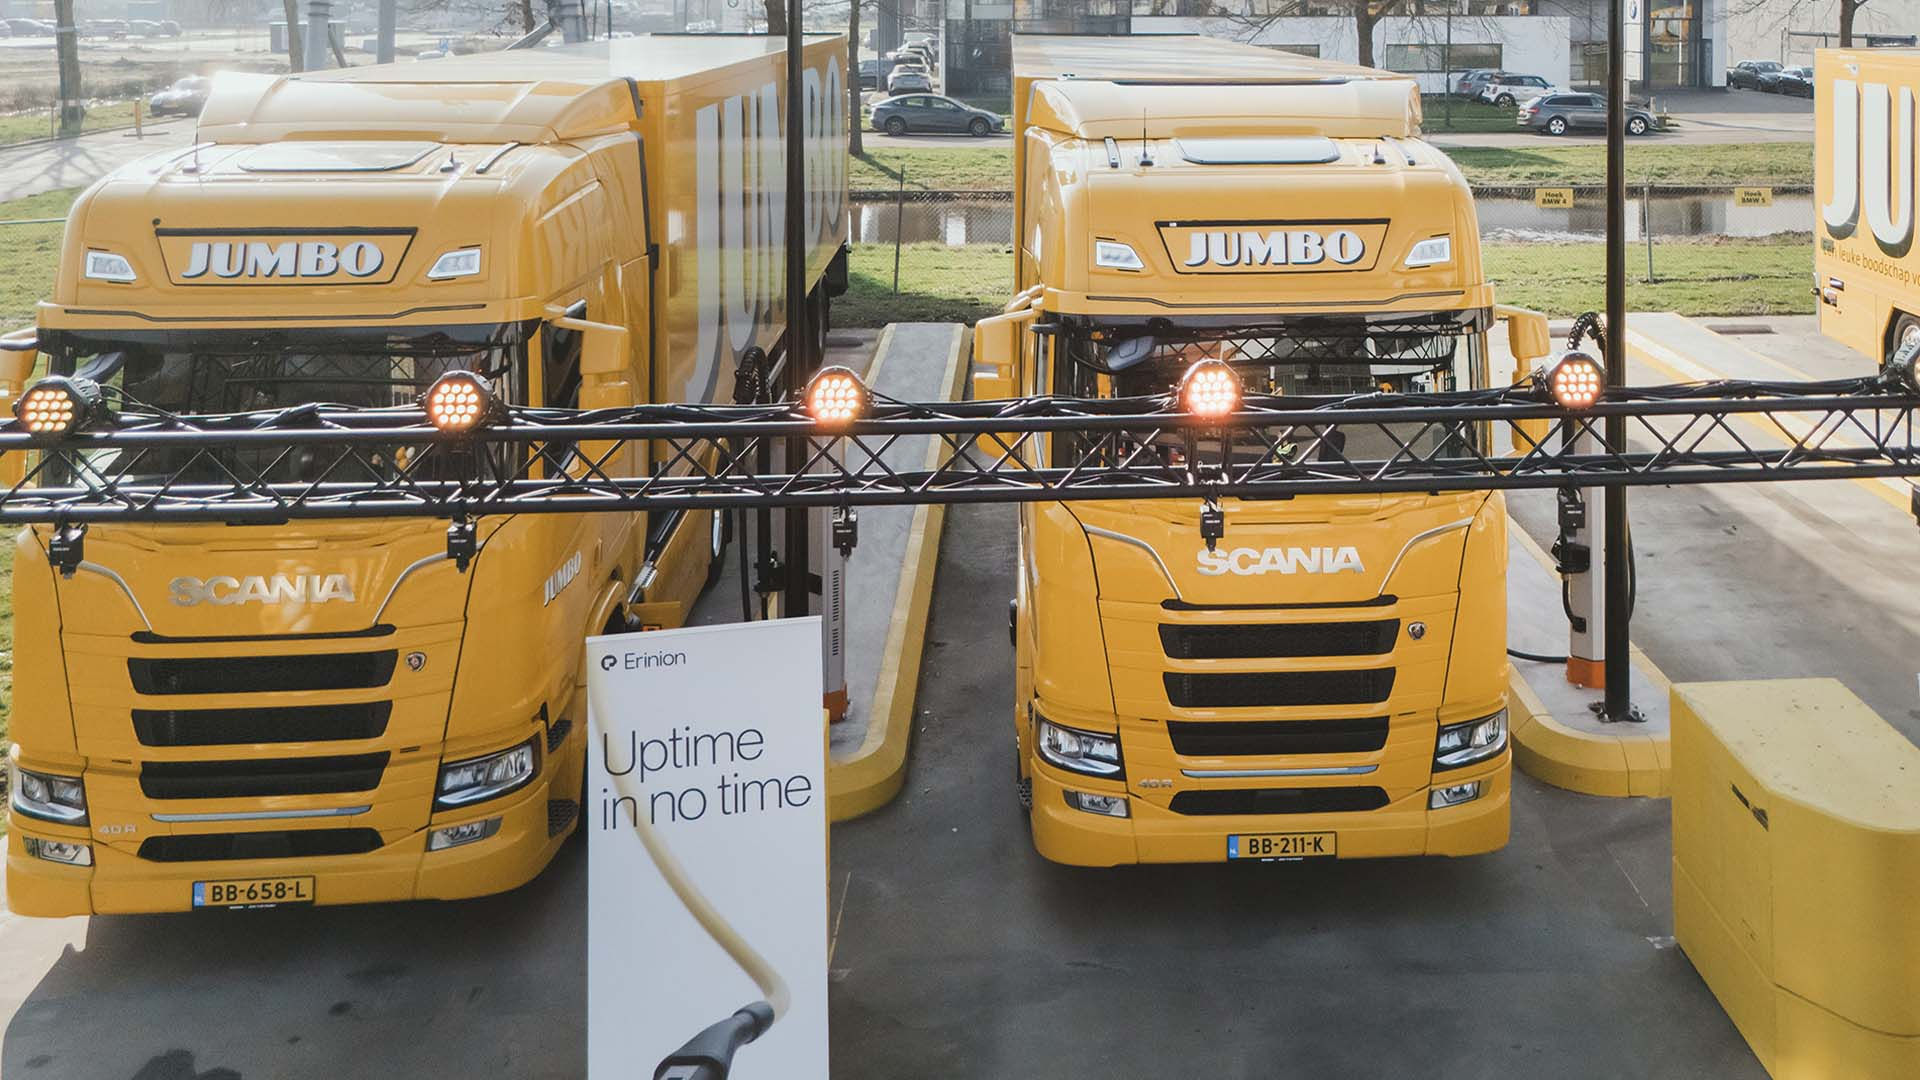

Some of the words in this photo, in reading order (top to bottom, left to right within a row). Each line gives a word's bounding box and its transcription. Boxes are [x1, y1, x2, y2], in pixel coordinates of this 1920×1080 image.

[181, 241, 384, 279] JUMBO
[1183, 230, 1366, 267] JUMBO
[1861, 252, 1910, 289] boodschap
[544, 551, 582, 608] JUMBO
[1196, 546, 1365, 576] SCANIA
[168, 573, 356, 606] SCANIA
[624, 651, 687, 671] Erinion
[603, 726, 764, 783] Uptime
[603, 788, 638, 830] in
[651, 788, 707, 825] no
[717, 773, 812, 816] time
[1249, 836, 1324, 855] BB-211-K
[211, 881, 306, 902] BB-658-L
